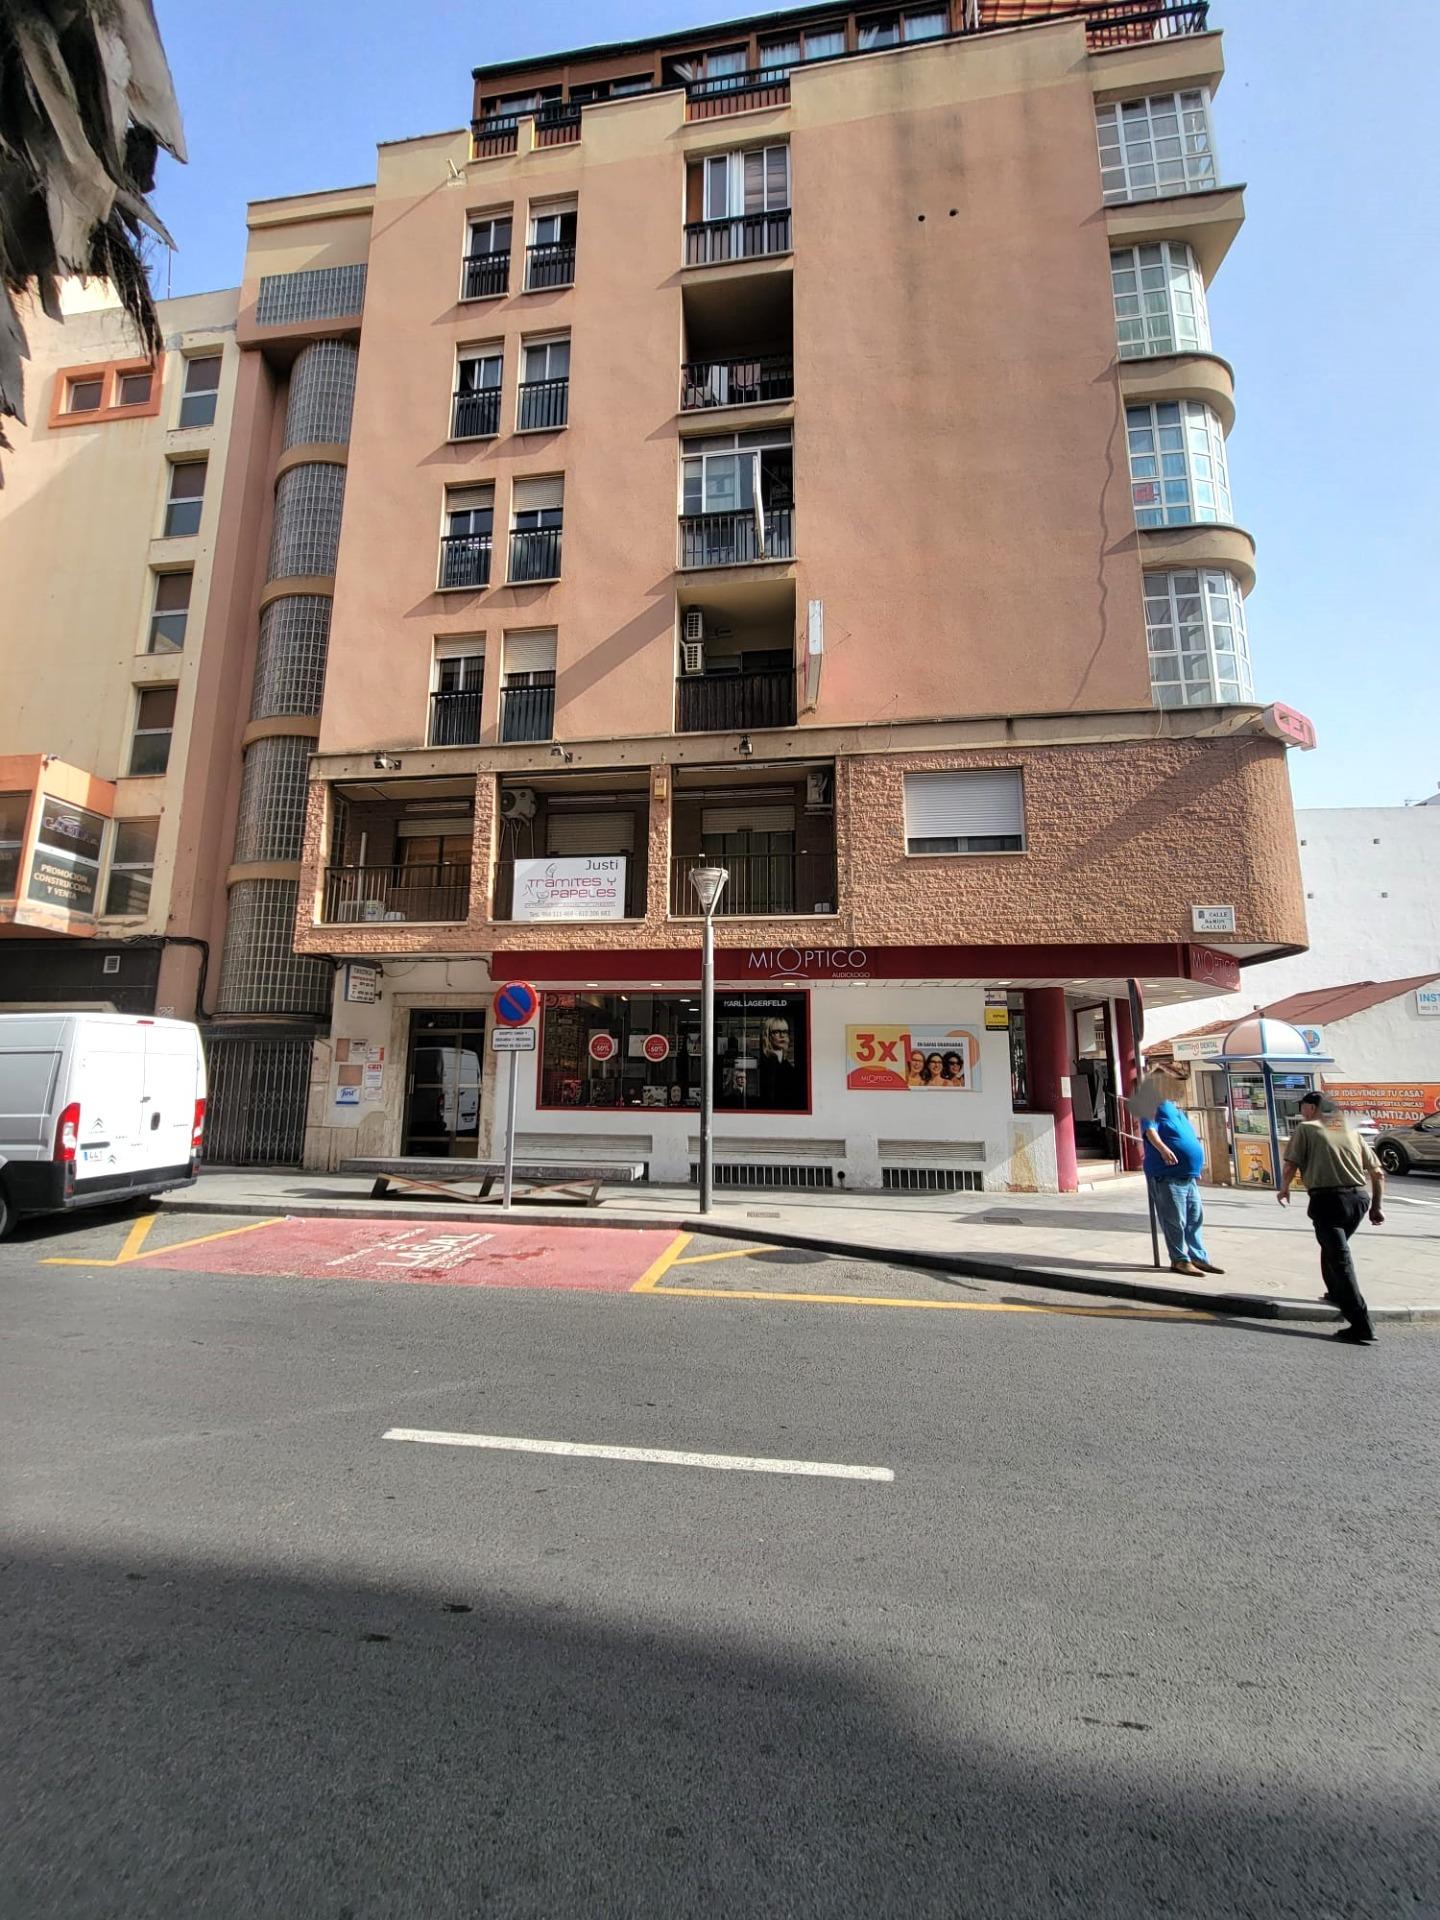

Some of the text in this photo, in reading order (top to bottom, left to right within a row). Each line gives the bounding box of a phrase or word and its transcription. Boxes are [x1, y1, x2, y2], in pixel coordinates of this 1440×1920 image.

[585, 860, 619, 871] Justi
[54, 887, 77, 900] VENTA
[743, 999, 787, 1007] LAGERFELD
[1399, 1090, 1425, 1098] CASA?
